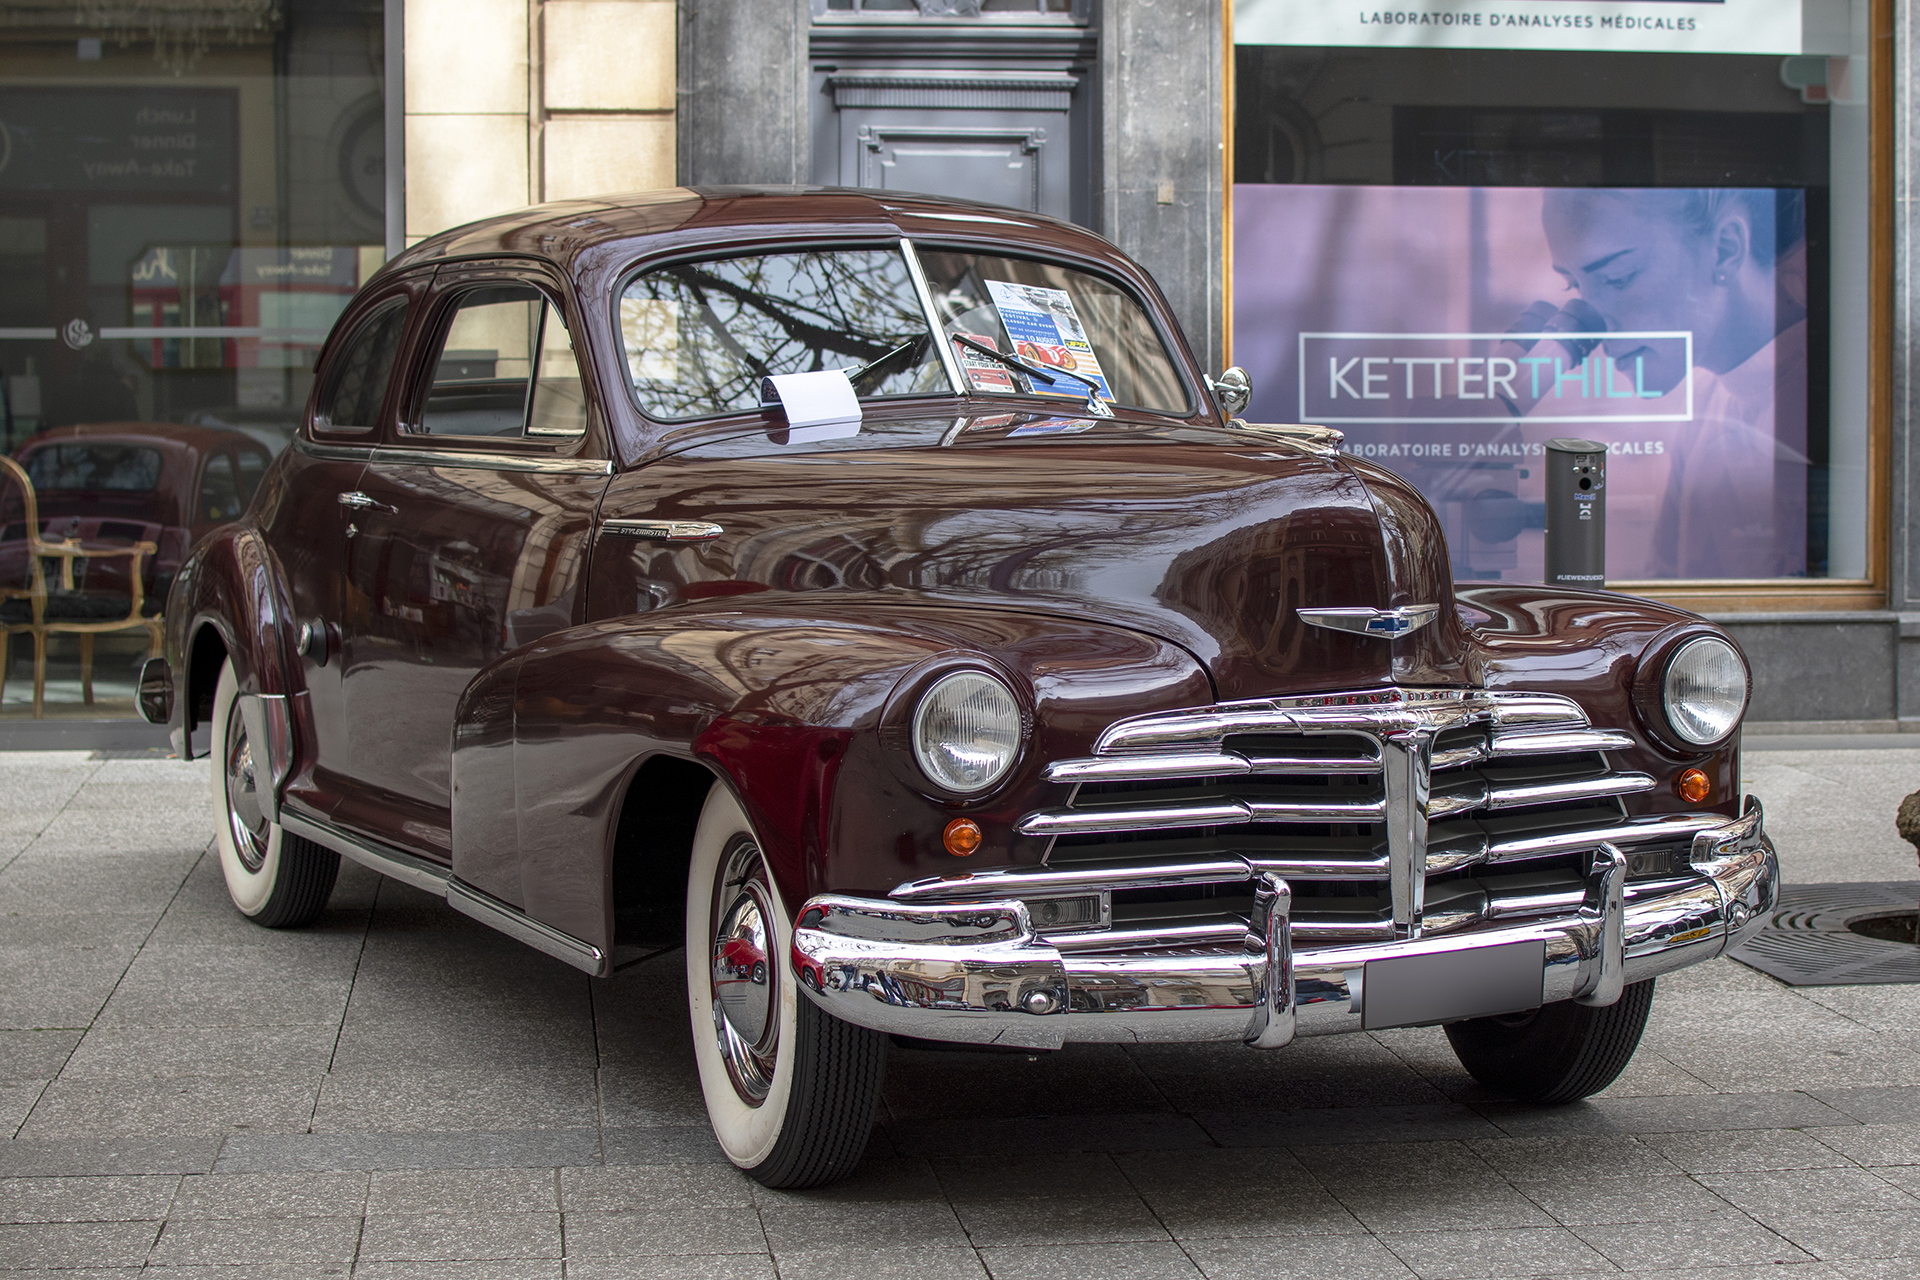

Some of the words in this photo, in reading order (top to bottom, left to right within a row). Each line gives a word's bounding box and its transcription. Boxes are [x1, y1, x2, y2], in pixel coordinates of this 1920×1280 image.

[1360, 11, 1483, 26] LABORATOIRE
[1490, 13, 1594, 29] D'ANALYSES
[1600, 13, 1697, 31] MÉDICALES
[1036, 336, 1059, 345] AUGUST
[1329, 356, 1664, 400] KETTERTHILL
[1341, 443, 1453, 457] ABORATOIRE
[1458, 442, 1546, 457] D'ANALYS
[620, 528, 667, 537] STYLEMASTER
[1302, 691, 1450, 707] CHEVROLET
